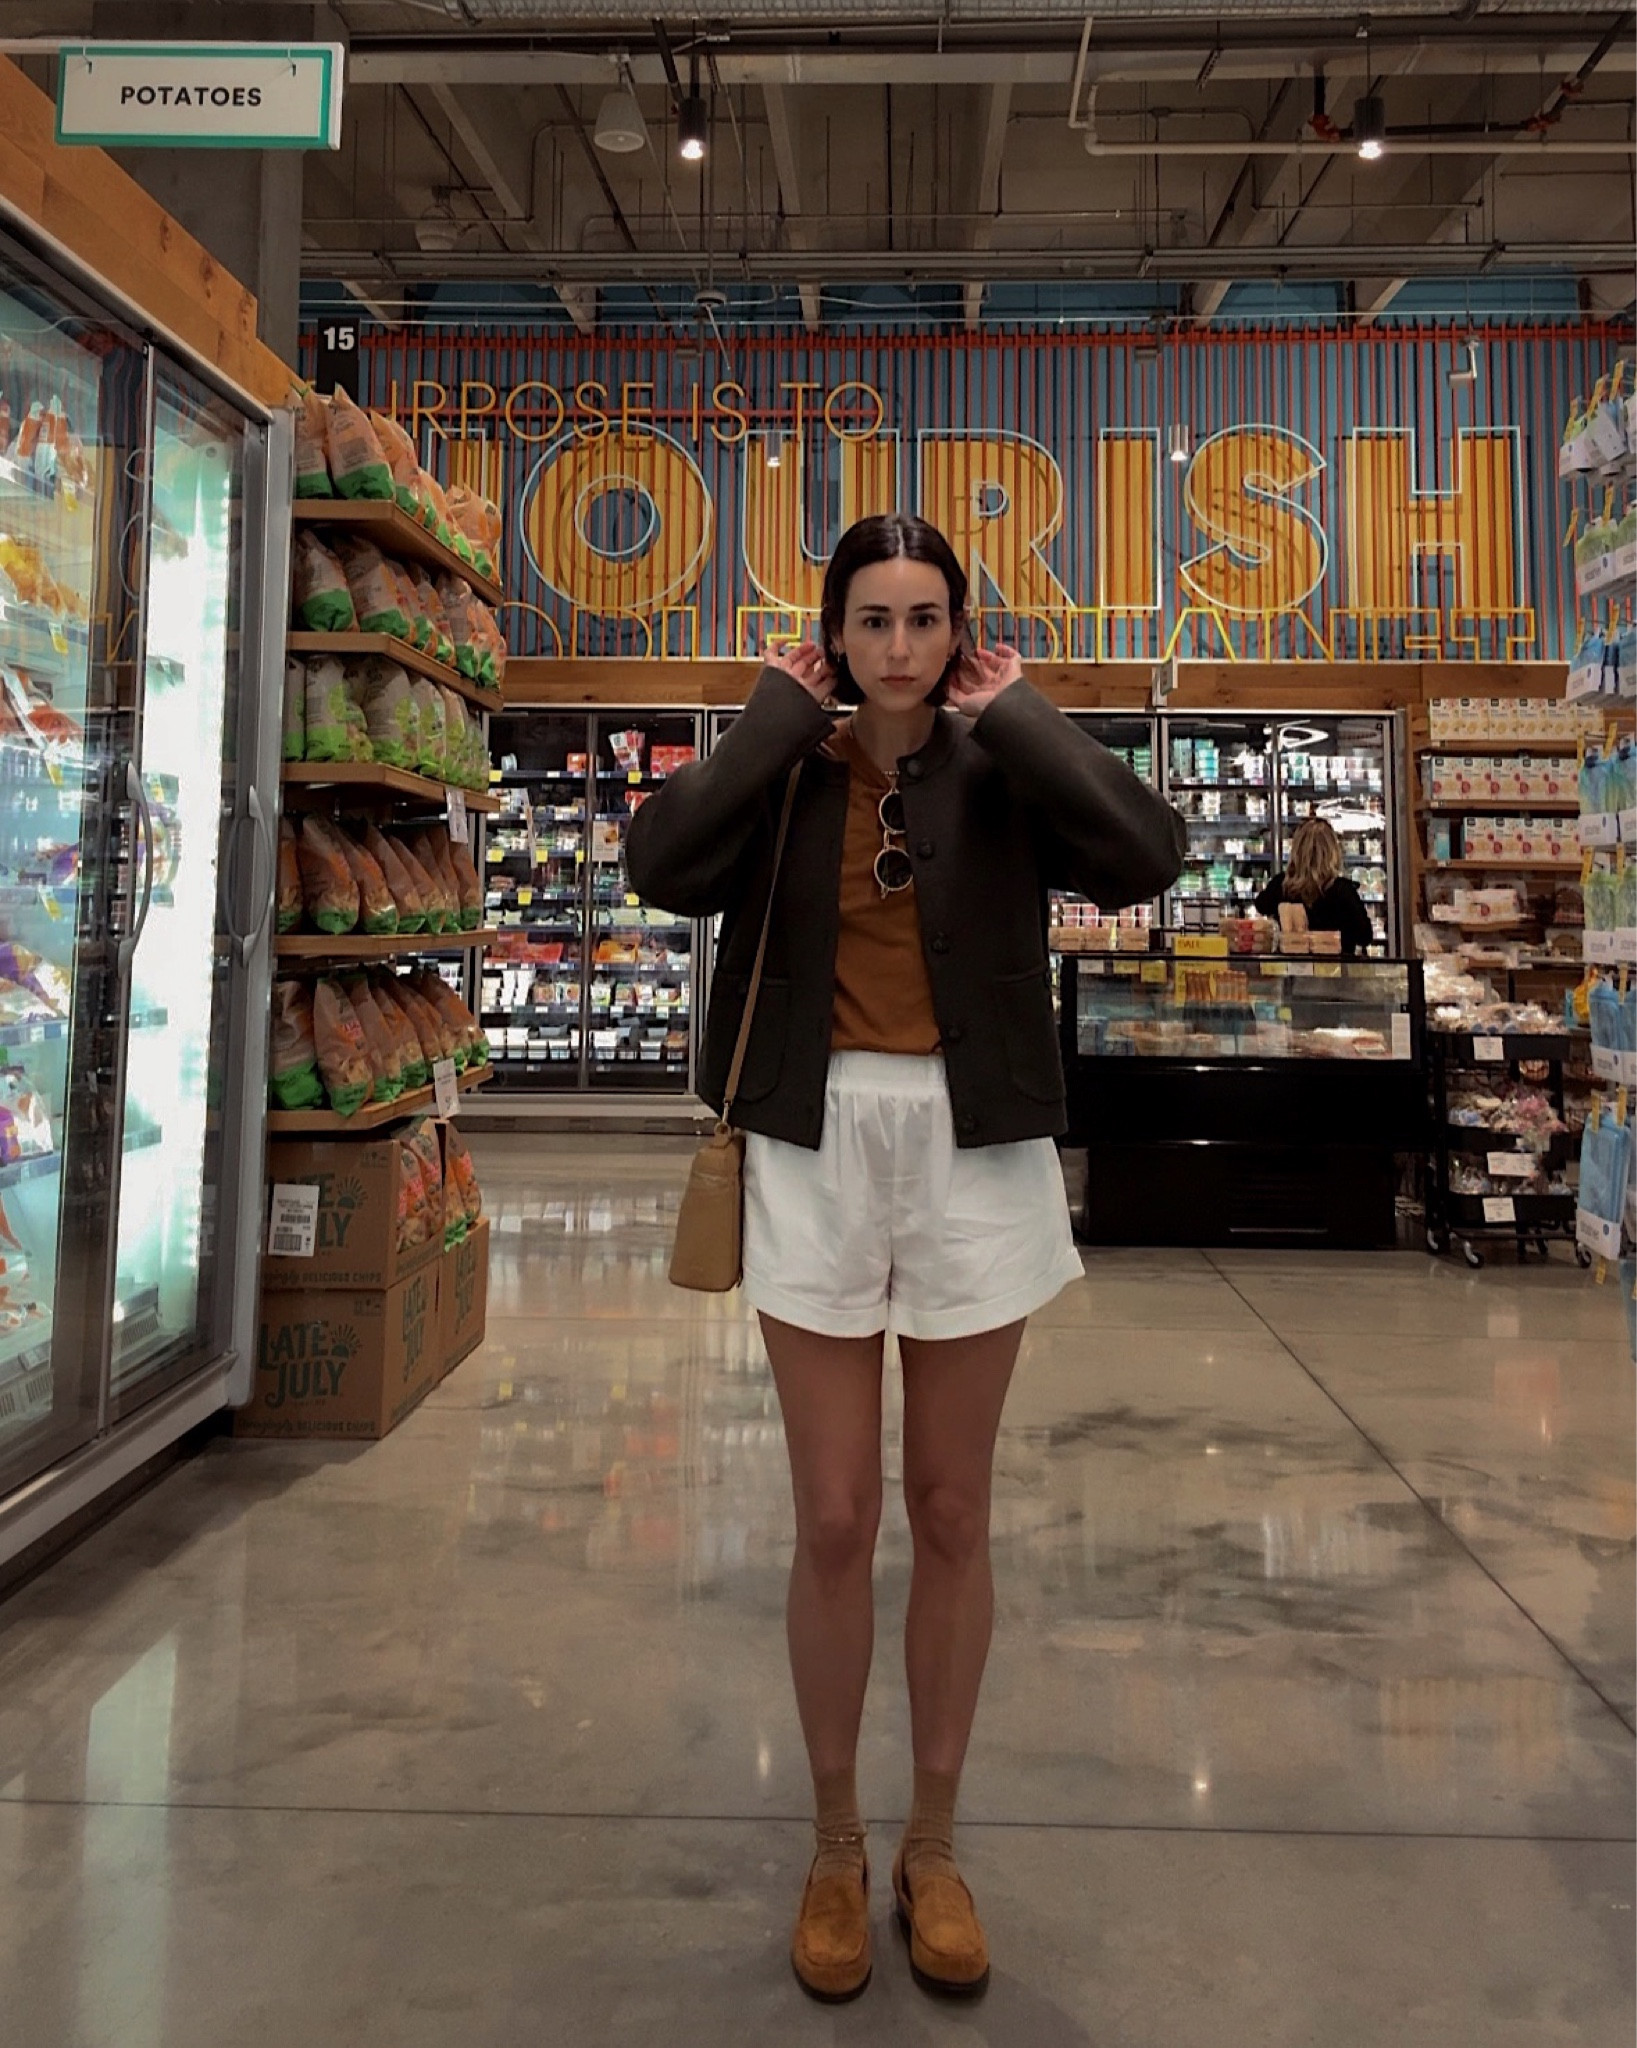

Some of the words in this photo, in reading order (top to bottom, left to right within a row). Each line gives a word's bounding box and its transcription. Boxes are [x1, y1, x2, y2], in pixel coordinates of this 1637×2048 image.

[120, 86, 262, 107] POTATOES
[323, 326, 355, 350] 15
[692, 381, 748, 443] IS
[780, 382, 884, 442] TO
[258, 1320, 330, 1371] LATE
[264, 1361, 347, 1408] JULY
